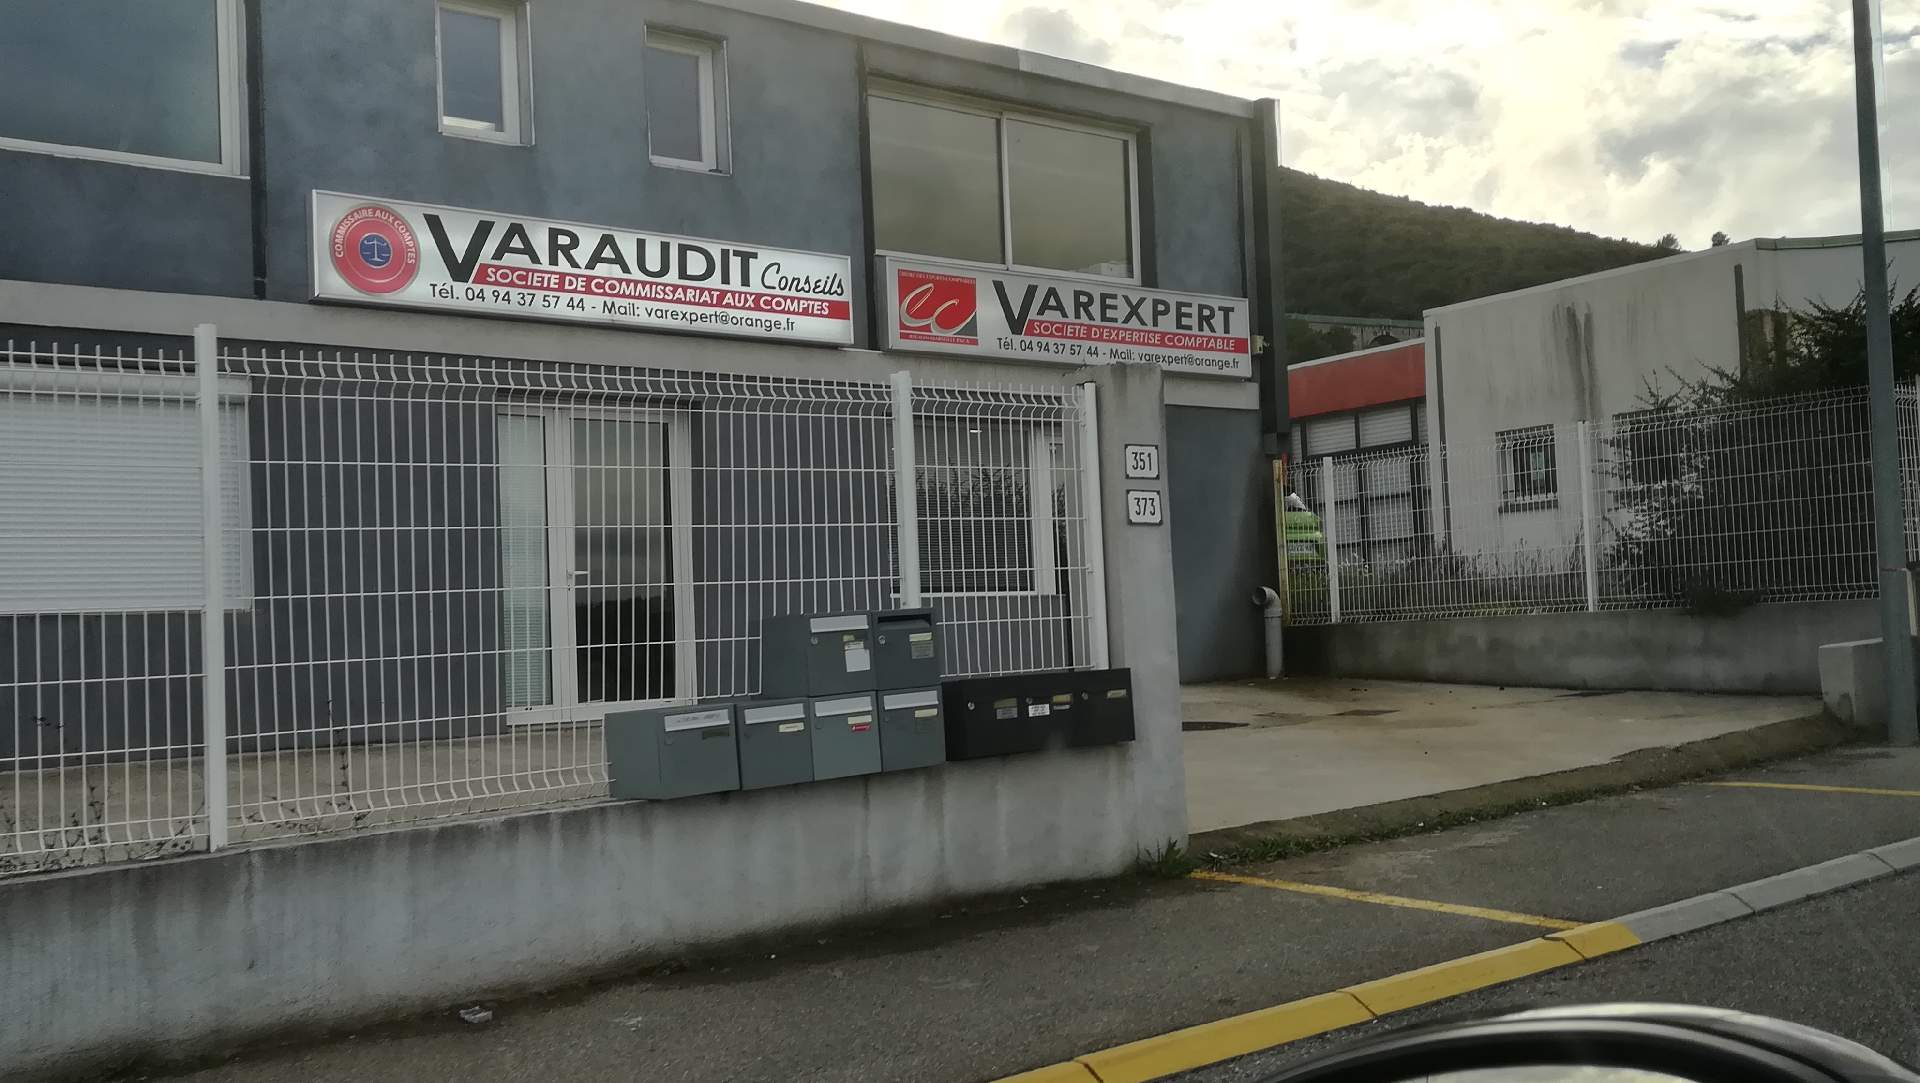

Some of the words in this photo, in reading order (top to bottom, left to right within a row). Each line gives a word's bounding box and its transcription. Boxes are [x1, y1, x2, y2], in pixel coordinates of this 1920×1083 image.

[334, 208, 374, 258] COMMISSAIRE
[374, 209, 394, 224] AUX
[394, 221, 416, 265] COMPTES
[423, 213, 758, 287] VARAUDIT
[761, 262, 845, 297] Conseils
[429, 283, 460, 300] Tél.
[465, 287, 486, 303] 04
[492, 290, 512, 305] 94
[517, 292, 536, 307] 37
[541, 294, 560, 309] 57
[566, 297, 586, 311] 44
[602, 301, 640, 318] Mail:
[645, 306, 795, 332] varexpert@orange.fr
[486, 267, 559, 288] SOCIETE
[564, 276, 587, 293] DE
[590, 277, 720, 305] COMMISSARIAT
[722, 293, 755, 308] AUX
[760, 296, 830, 315] COMPTES
[992, 280, 1235, 336] VAREXPERT
[997, 337, 1017, 351] Tél.
[1020, 340, 1034, 352] 04
[1036, 341, 1050, 353] 94
[1053, 343, 1066, 354] 37
[1070, 344, 1082, 356] 57
[1086, 346, 1099, 358] 44
[1109, 348, 1135, 361] Mail:
[1138, 353, 1239, 370] varexpert@orange.fr
[1033, 321, 1087, 338] SOCIETE
[1091, 328, 1161, 344] D'EXPERTISE
[1165, 334, 1235, 351] COMPTABLE
[1131, 451, 1152, 471] 351
[1134, 497, 1156, 516] 373
